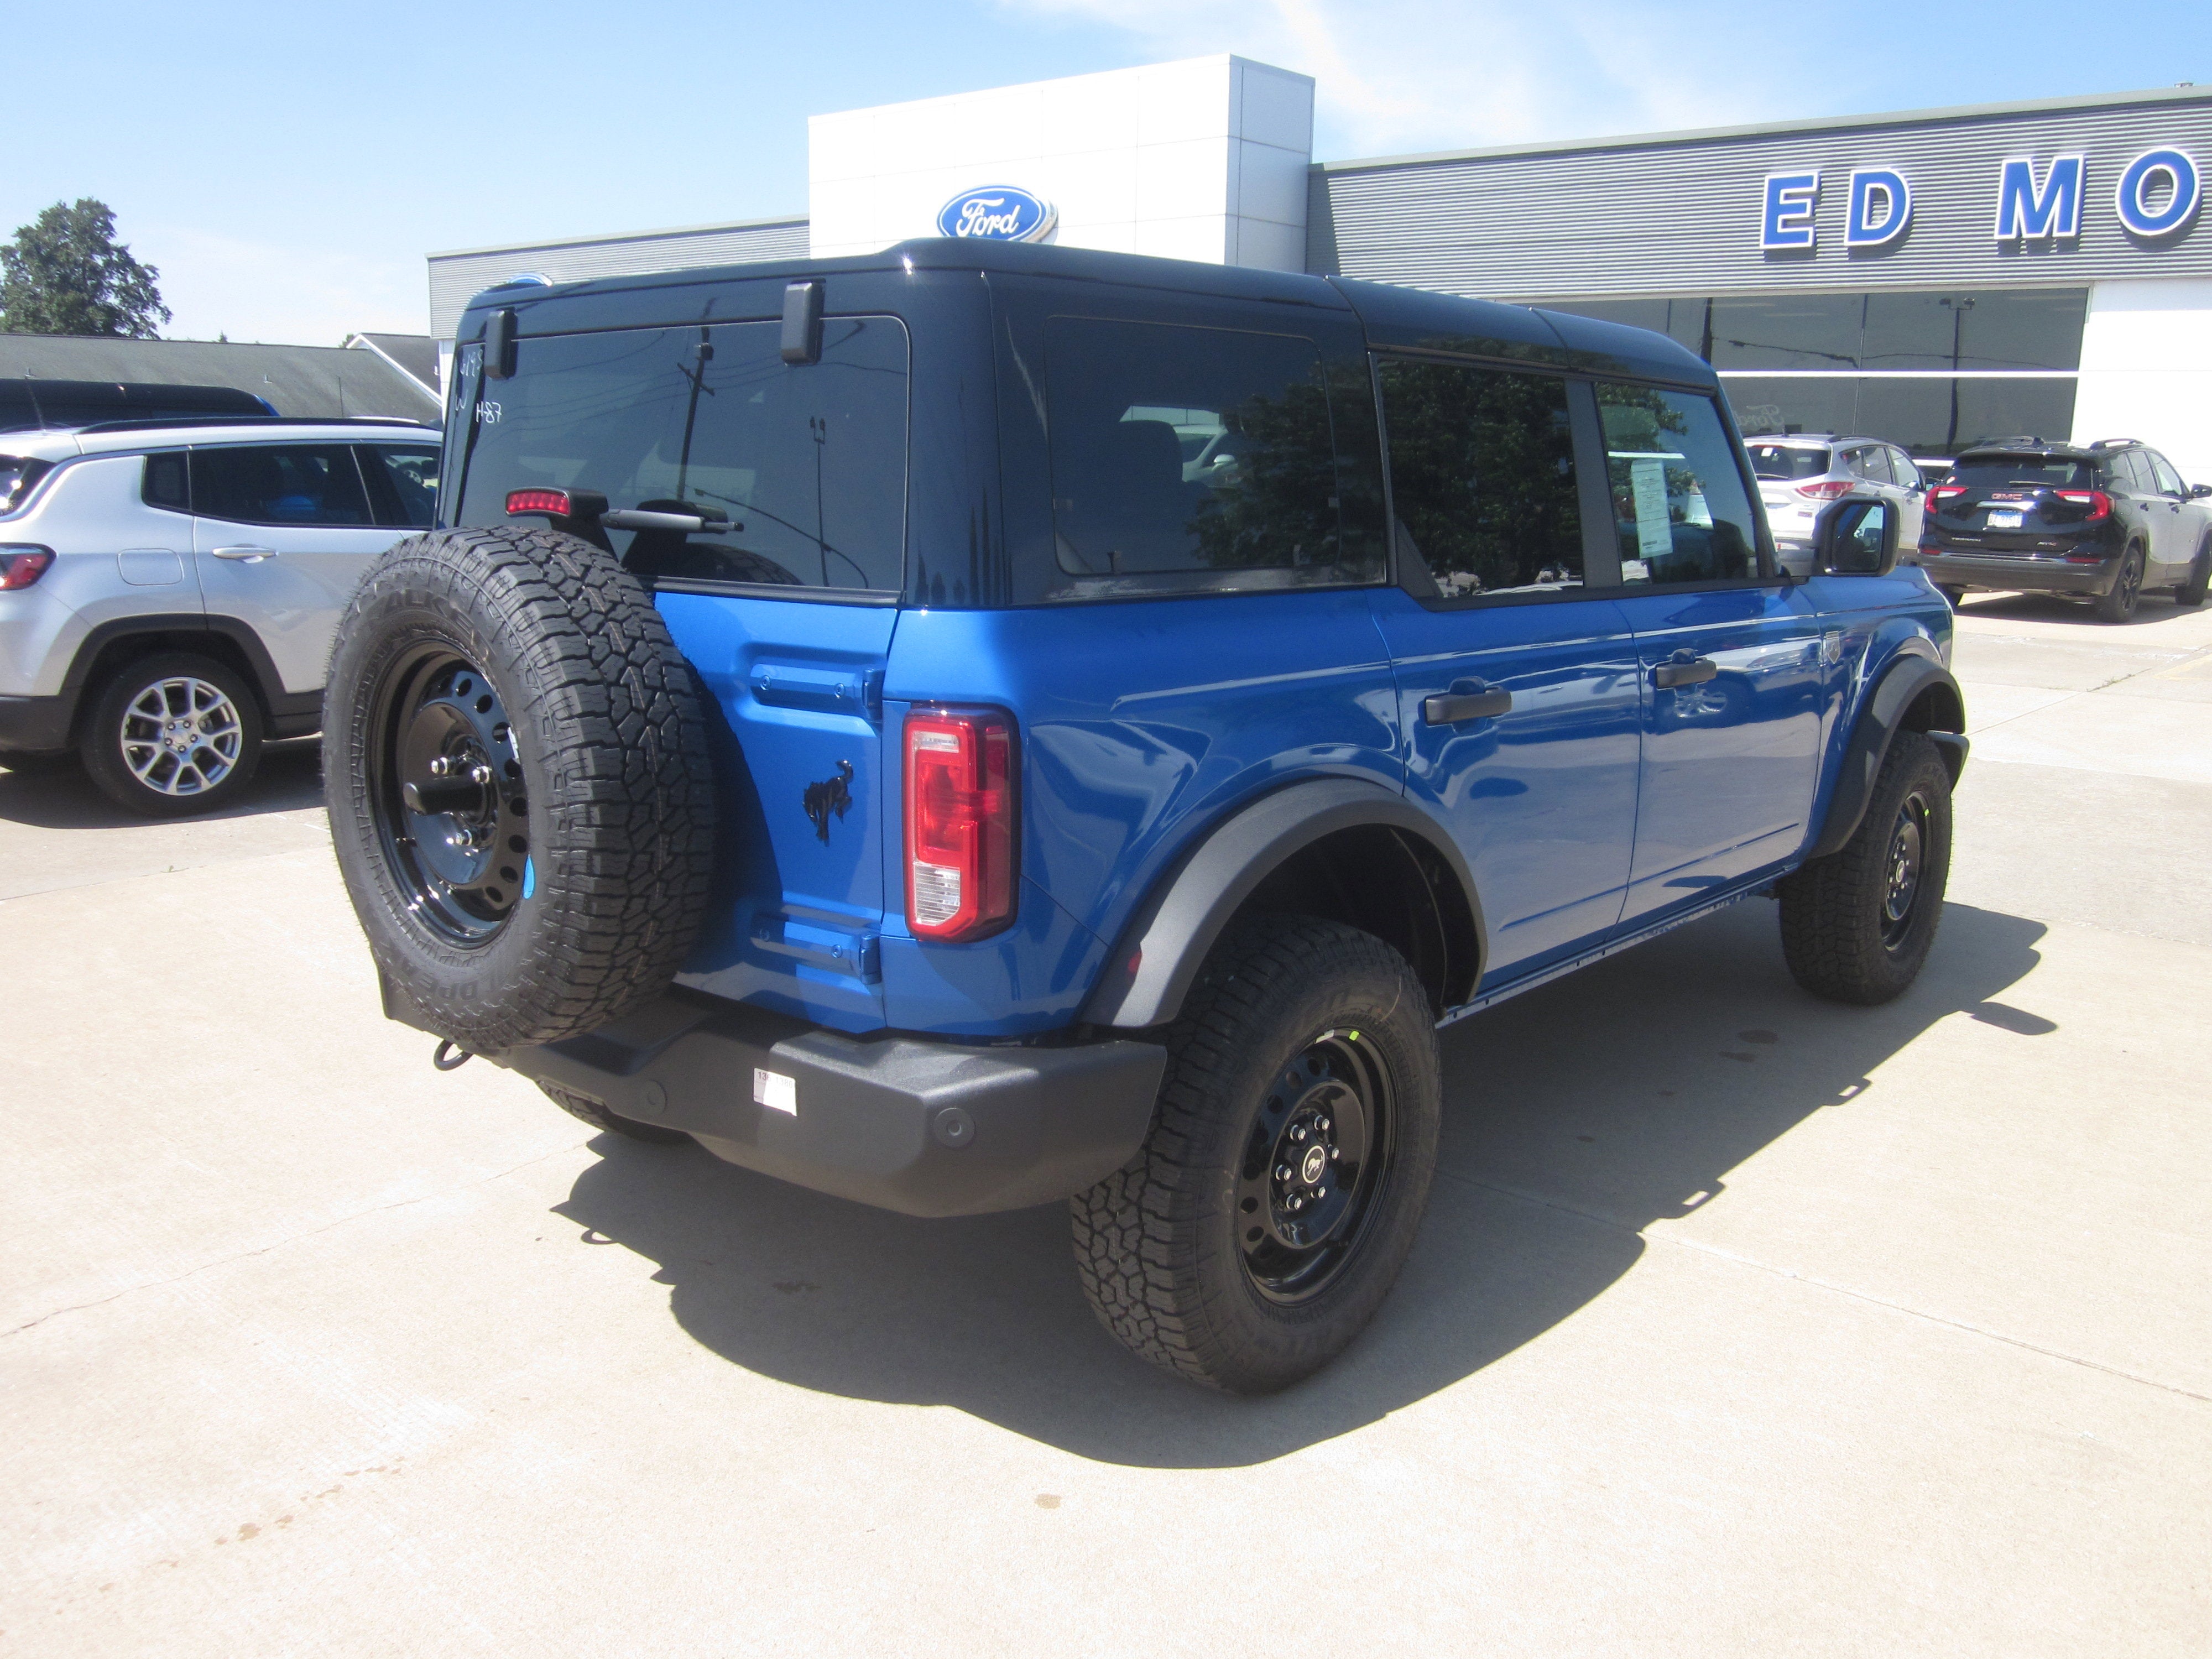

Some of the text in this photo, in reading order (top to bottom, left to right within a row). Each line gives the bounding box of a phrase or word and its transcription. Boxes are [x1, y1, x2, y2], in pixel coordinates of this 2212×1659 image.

[955, 197, 1020, 237] Ford
[1760, 145, 2201, 251] ED MO
